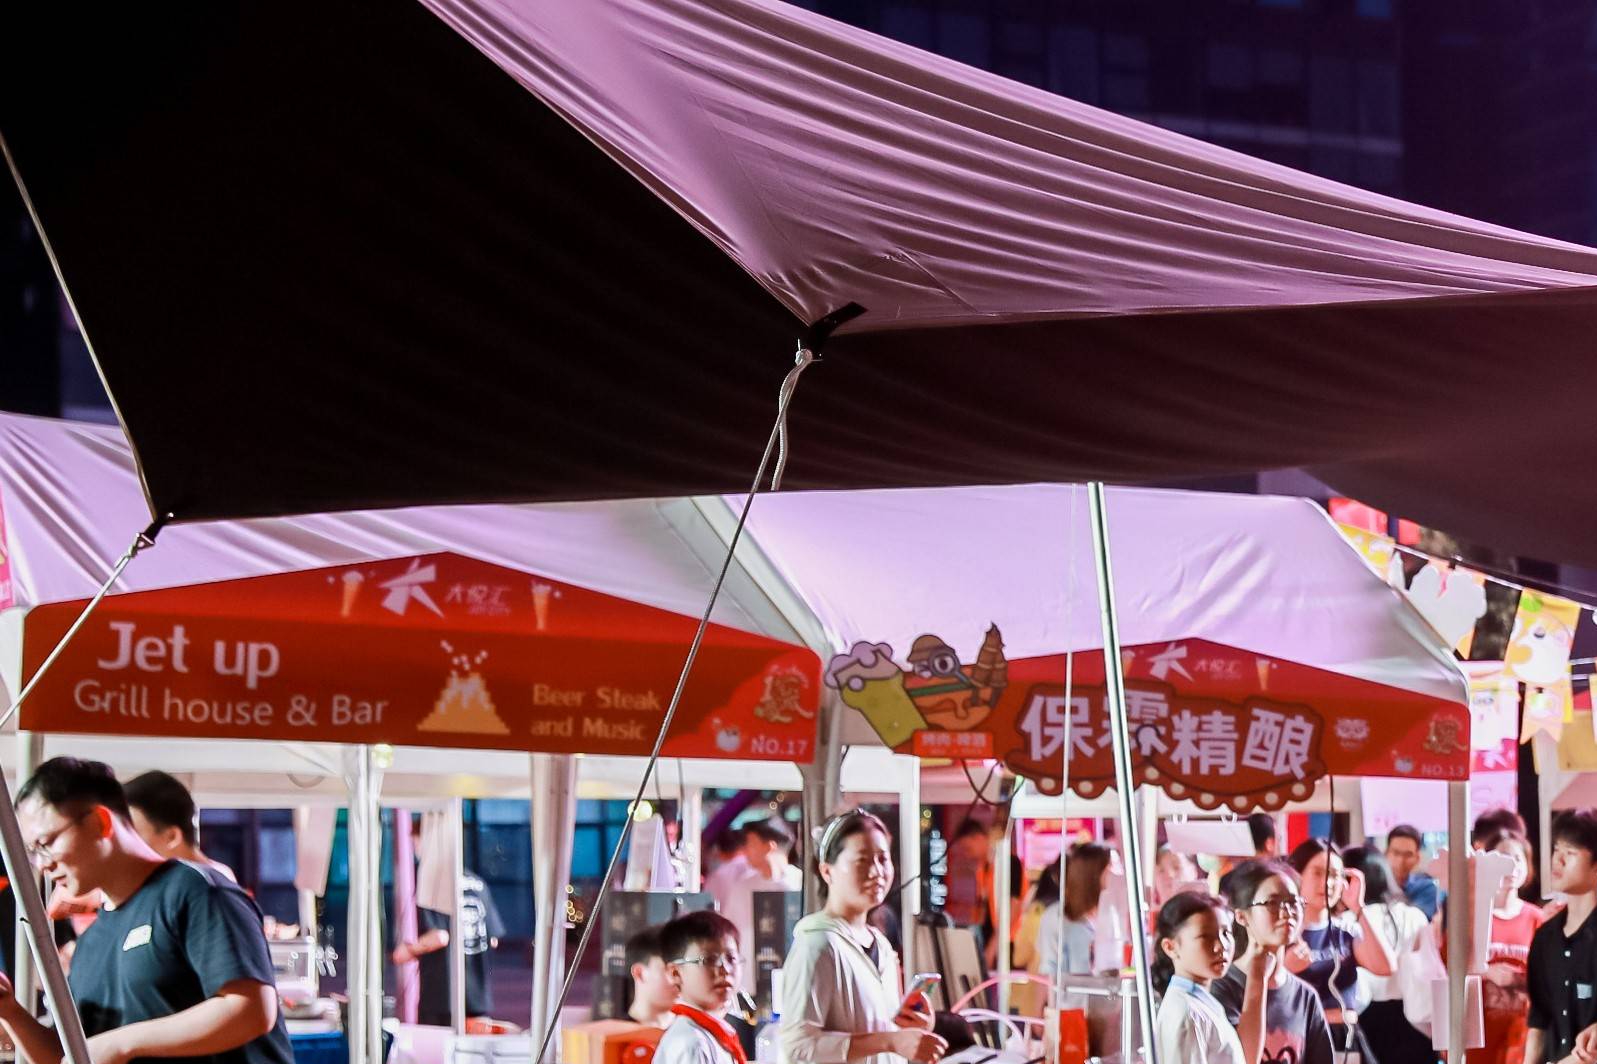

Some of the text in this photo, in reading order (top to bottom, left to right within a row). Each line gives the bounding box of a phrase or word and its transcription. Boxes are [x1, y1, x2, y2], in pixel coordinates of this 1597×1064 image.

[97, 620, 280, 690] Jet up
[73, 679, 388, 727] Grill house & Bar
[533, 684, 662, 711] Beer Steak
[531, 716, 646, 741] and Music
[751, 736, 808, 755] NO.17
